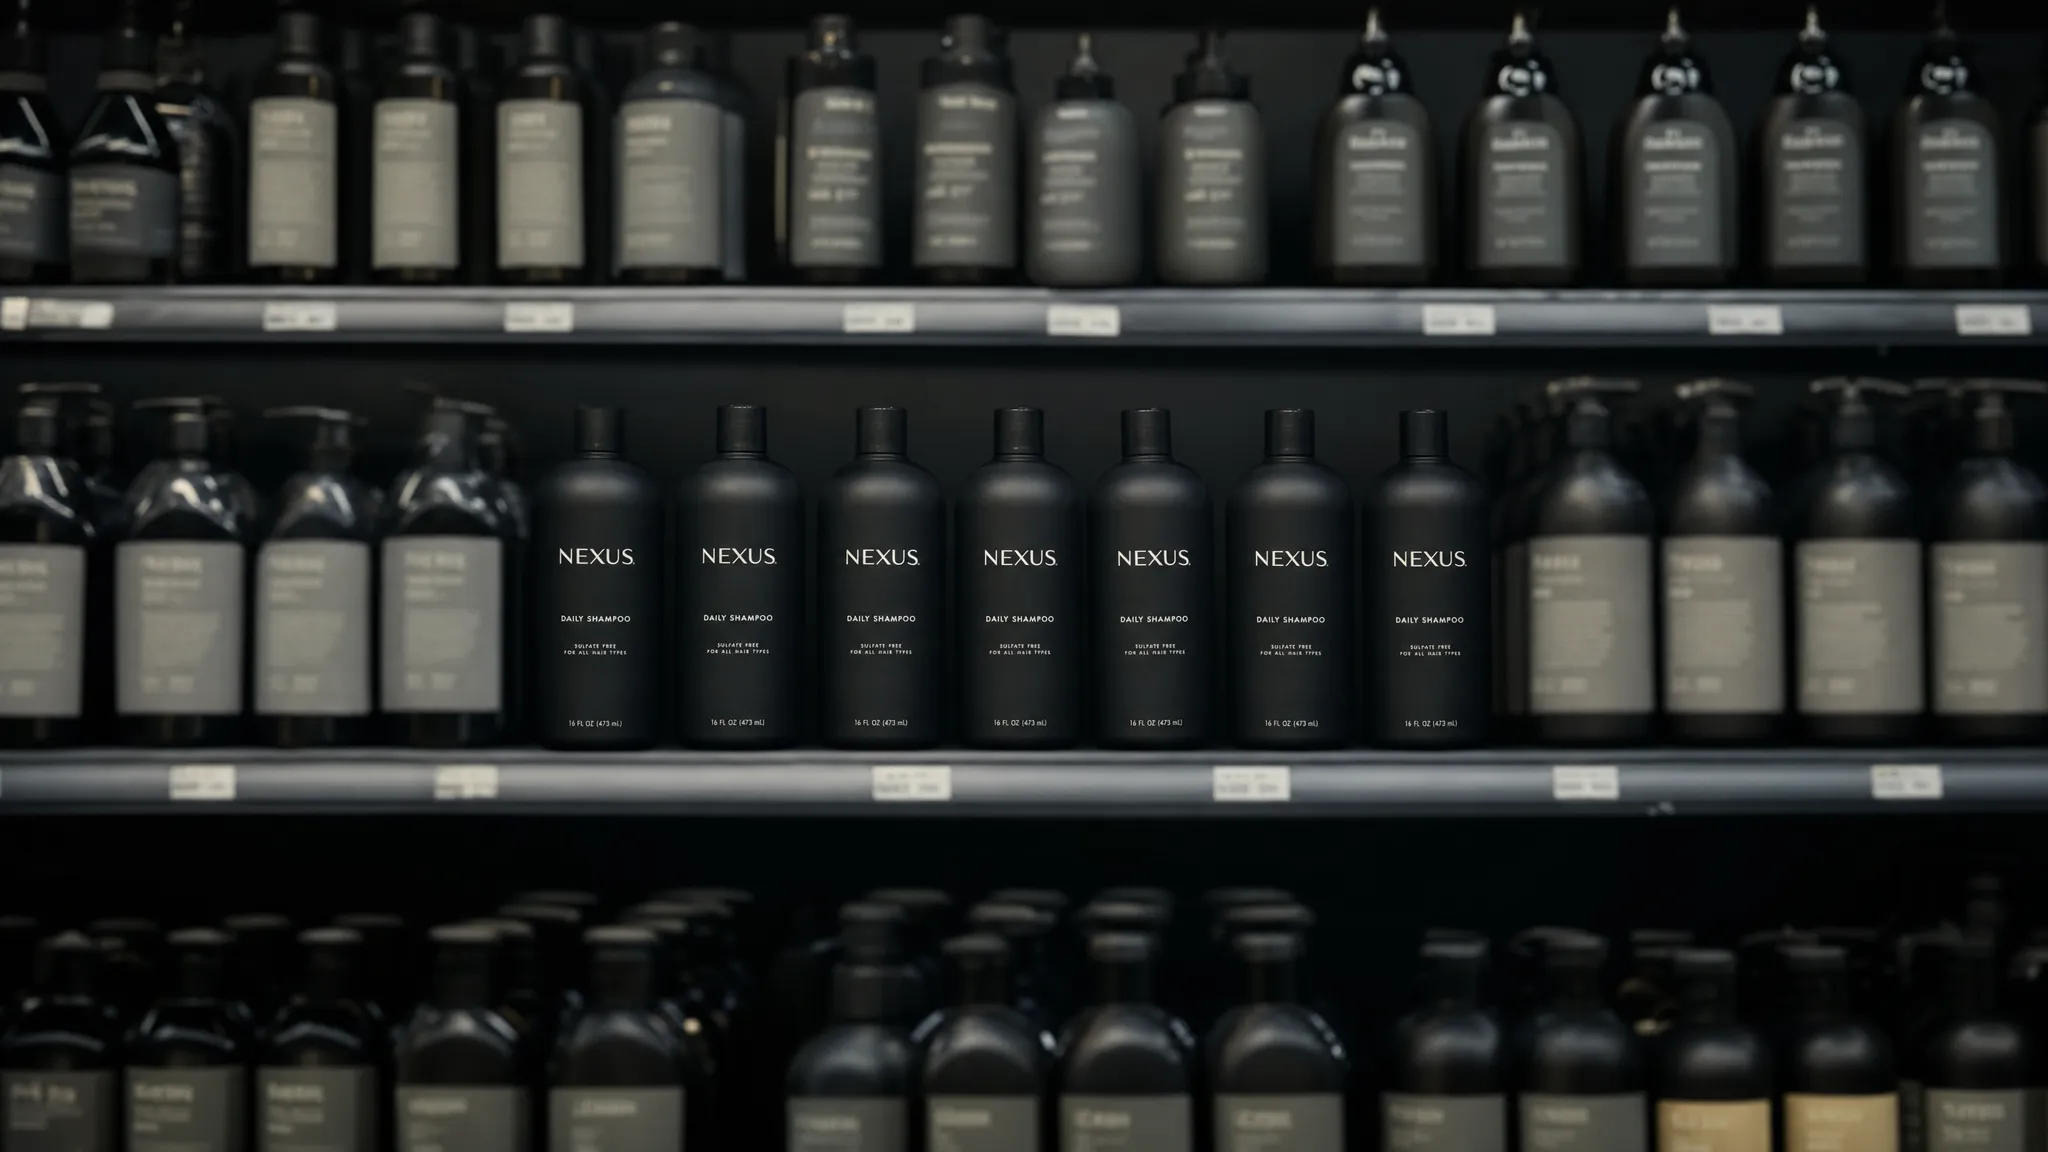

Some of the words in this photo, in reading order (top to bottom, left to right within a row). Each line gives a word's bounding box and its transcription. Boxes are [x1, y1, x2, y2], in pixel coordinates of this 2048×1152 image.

[560, 614, 584, 623] DAILY
[586, 614, 631, 623] SHAMPOO
[703, 614, 727, 622] DAILY
[729, 614, 774, 622] SHAMPOO
[846, 614, 871, 623] DAILY
[872, 614, 917, 623] SHAMPOO
[985, 615, 1009, 623] DAILY
[1011, 615, 1055, 623] SHAMPOO
[1119, 615, 1144, 624] DAILY
[1146, 615, 1189, 624] SHAMPOO
[1256, 615, 1281, 624] DAILY
[1282, 615, 1326, 624] SHAMPOO
[1395, 616, 1419, 625] DAILY
[1421, 616, 1465, 625] SHAMPOO
[568, 719, 576, 728] 16
[576, 719, 585, 728] FL
[584, 719, 595, 728] OZ
[595, 719, 610, 728] (473
[710, 718, 719, 727] 16
[718, 718, 727, 727] FL
[727, 718, 738, 727] OZ
[738, 718, 753, 727] (473
[854, 718, 862, 728] 16
[862, 718, 870, 728] FL
[871, 718, 881, 728] OZ
[881, 718, 896, 728] (473
[993, 719, 1002, 728] 16
[1001, 719, 1010, 728] FL
[1010, 719, 1020, 728] OZ
[1021, 719, 1036, 728] (473
[1129, 718, 1137, 728] 16
[1137, 718, 1146, 728] FL
[1146, 718, 1157, 728] OZ
[1157, 718, 1172, 728] (473
[1264, 719, 1273, 728] 16
[1273, 719, 1281, 728] FL
[1281, 719, 1292, 728] OZ
[1292, 719, 1307, 728] (473
[1404, 719, 1412, 728] 16
[1413, 719, 1421, 728] FL
[1421, 719, 1432, 728] OZ
[1432, 719, 1446, 728] (473
